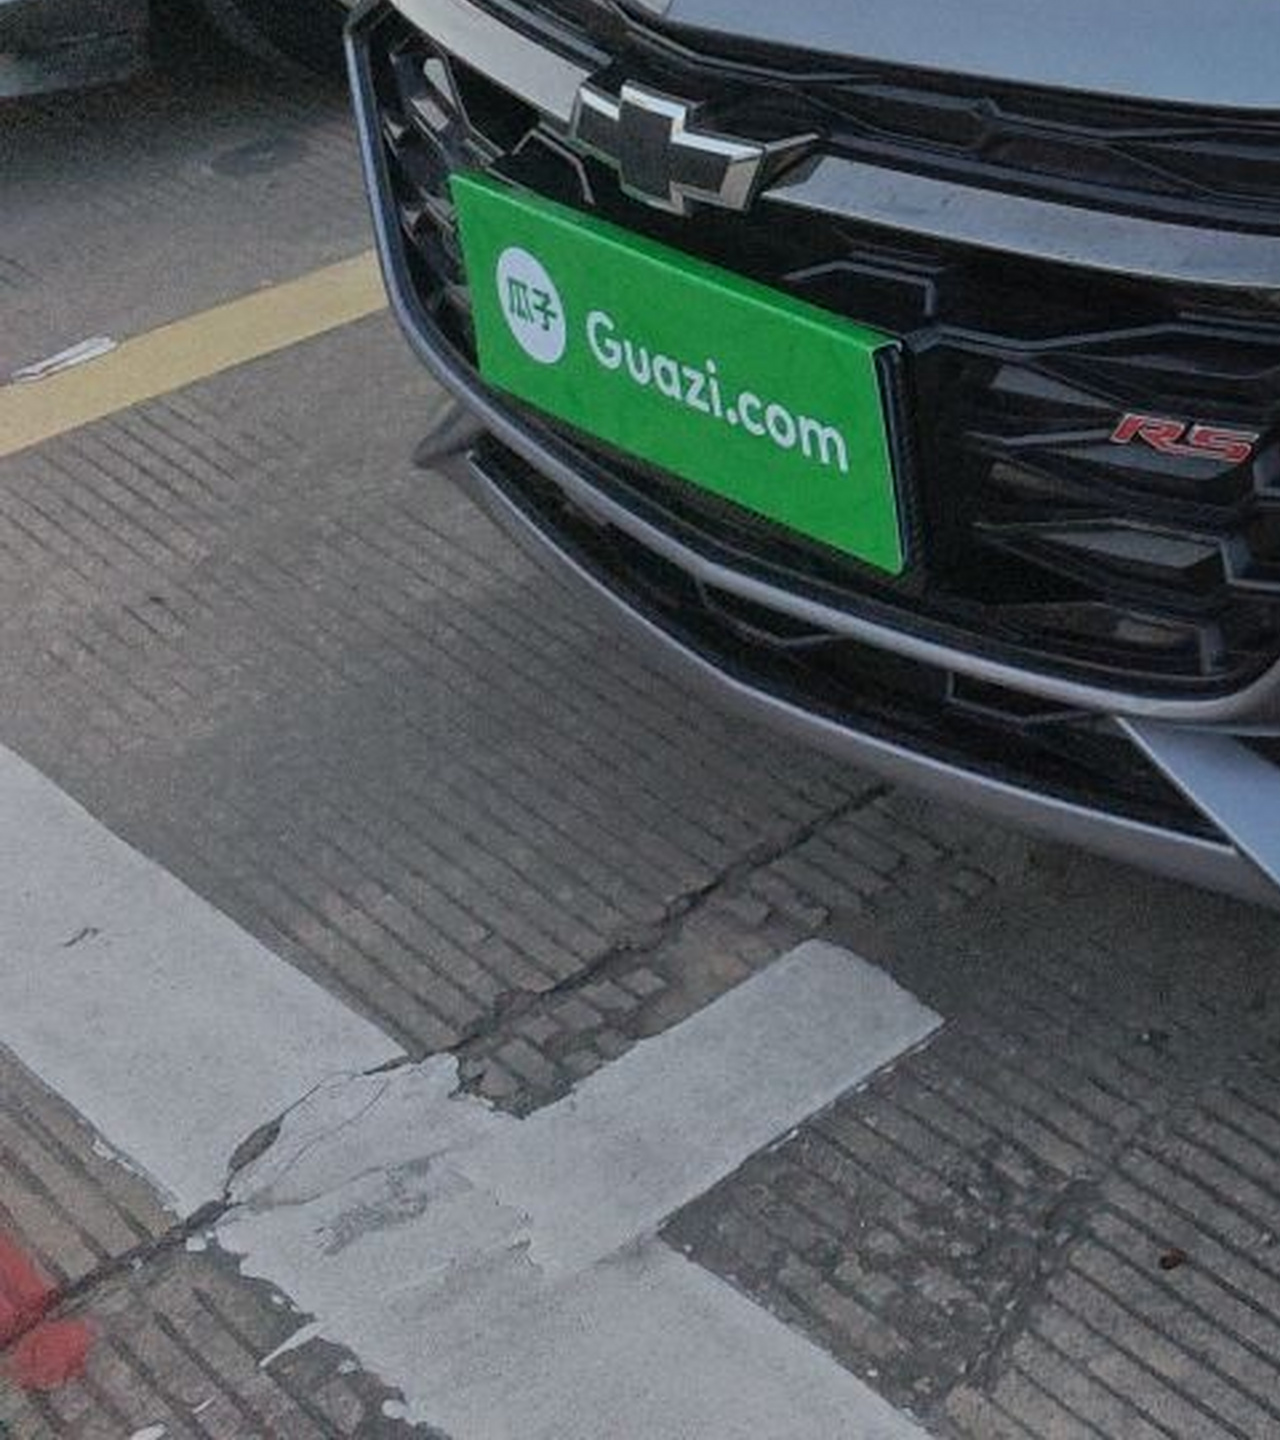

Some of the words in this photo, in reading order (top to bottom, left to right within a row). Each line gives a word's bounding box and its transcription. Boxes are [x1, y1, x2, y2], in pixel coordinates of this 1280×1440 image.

[506, 276, 558, 333] 瓜子
[586, 310, 849, 474] Guazi.com
[1109, 412, 1260, 463] RS
